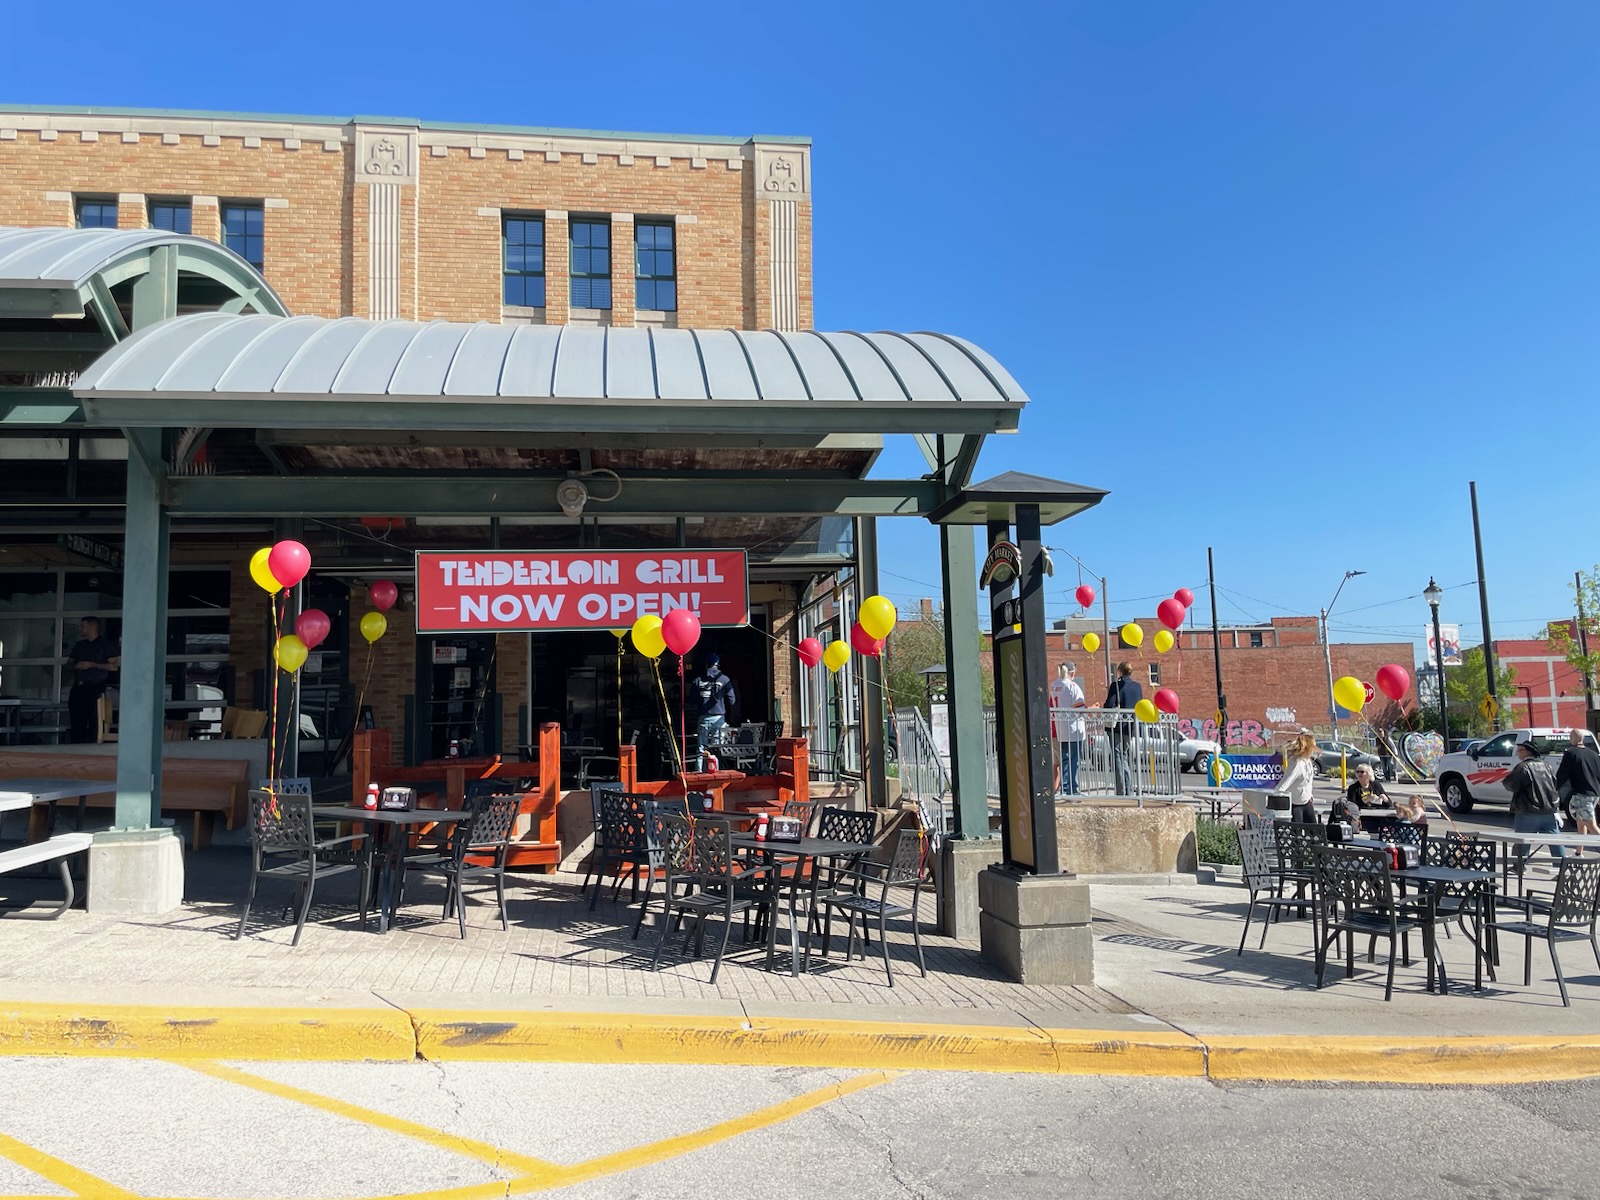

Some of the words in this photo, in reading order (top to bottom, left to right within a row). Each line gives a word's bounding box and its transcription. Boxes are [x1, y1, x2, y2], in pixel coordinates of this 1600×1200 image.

[994, 547, 1014, 563] MARKET
[439, 559, 619, 586] TENDERLOIN
[635, 558, 724, 585] GRILL
[460, 594, 565, 623] NOW
[577, 591, 701, 621] OPEN!
[1009, 651, 1030, 841] experience
[1232, 763, 1267, 774] THANK
[1267, 764, 1282, 774] YO
